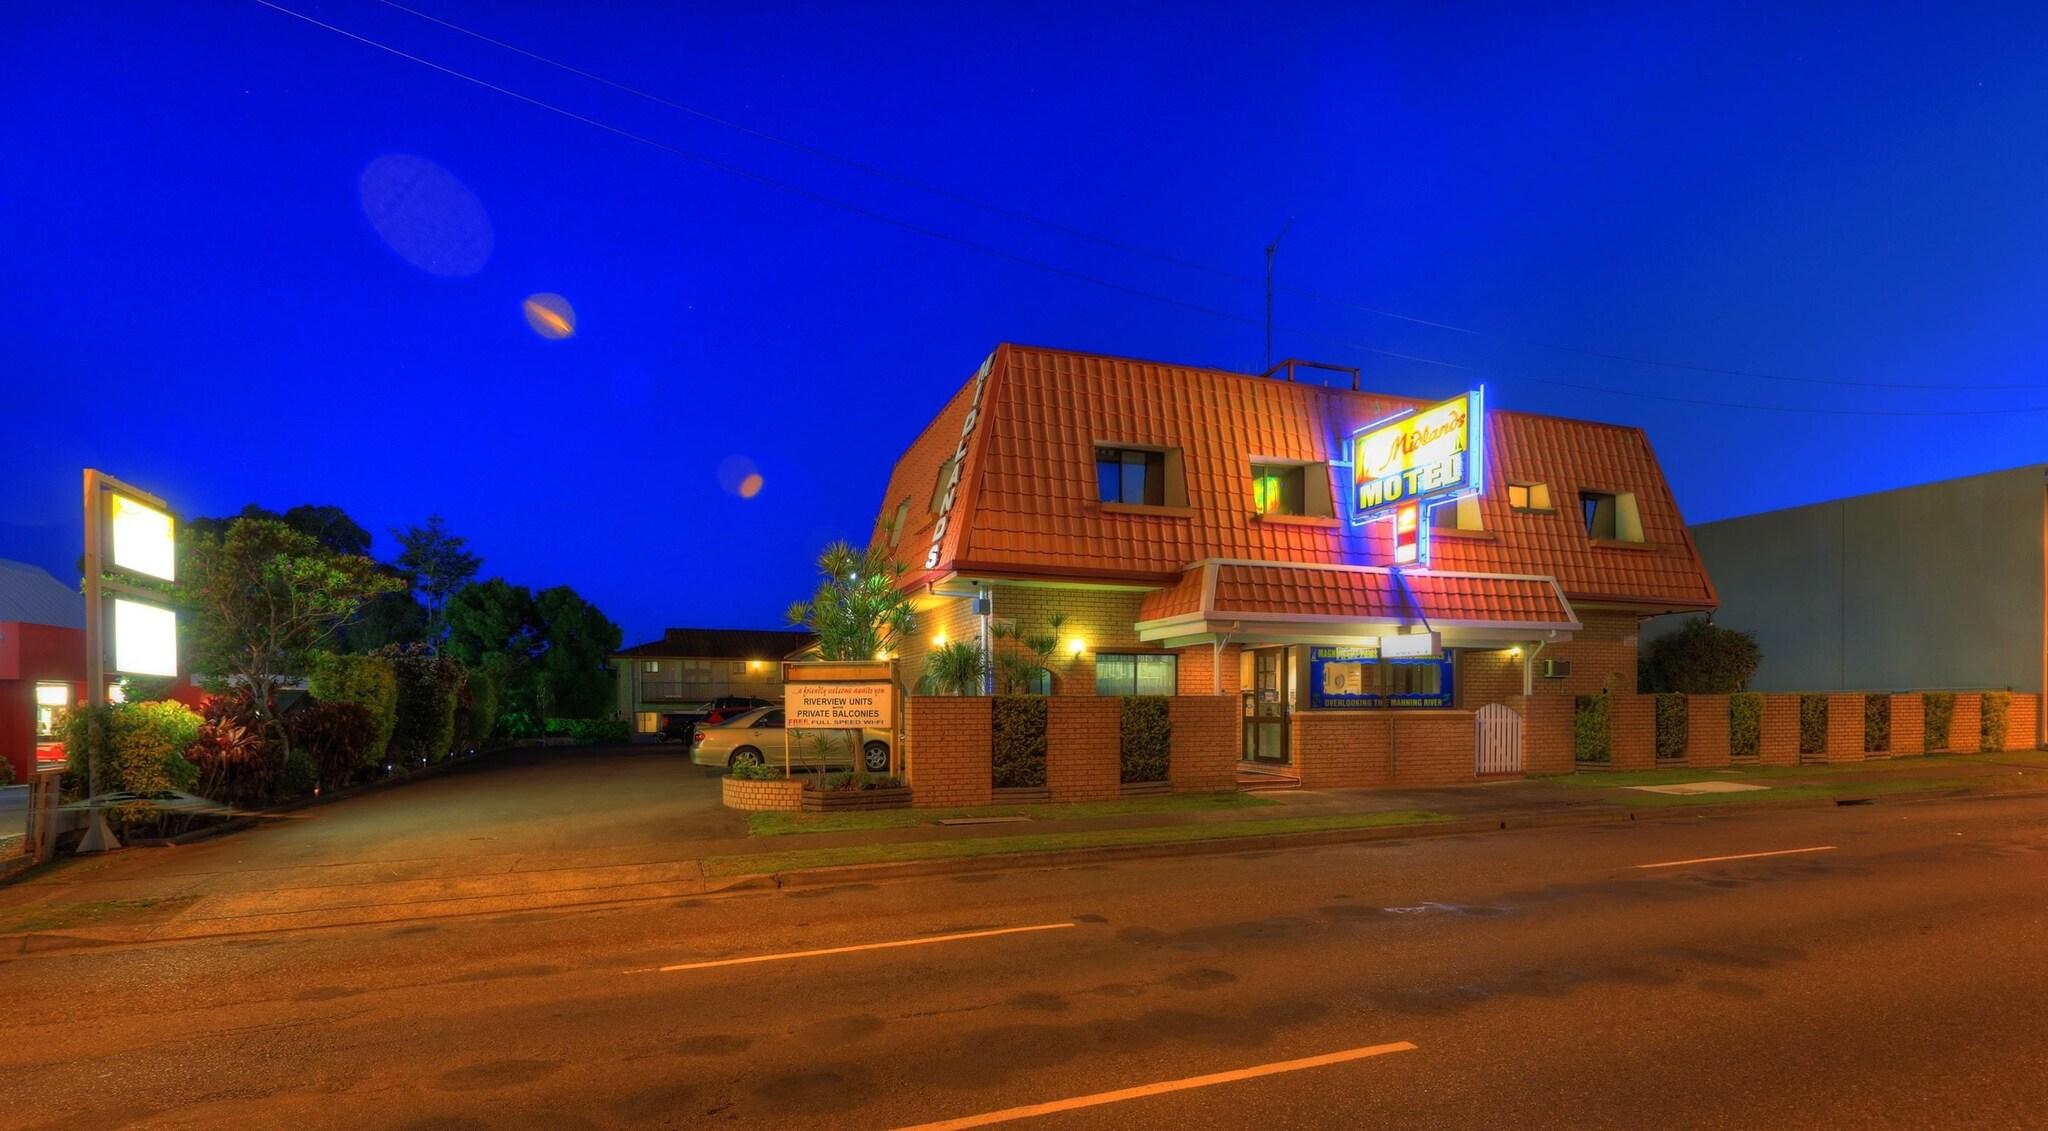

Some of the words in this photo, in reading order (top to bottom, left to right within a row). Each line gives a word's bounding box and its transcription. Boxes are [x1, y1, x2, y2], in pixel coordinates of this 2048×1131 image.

[1378, 410, 1466, 472] Midlands
[925, 352, 997, 569] MIDLANDS
[803, 698, 847, 706] RIVERVIEW
[1325, 698, 1372, 707] OVERLOOKING
[1391, 698, 1422, 707] MANNING
[1424, 698, 1442, 707] RIVER
[797, 710, 830, 718] PRIVATE
[832, 710, 879, 718] BALCONIES
[788, 718, 809, 727] FREE
